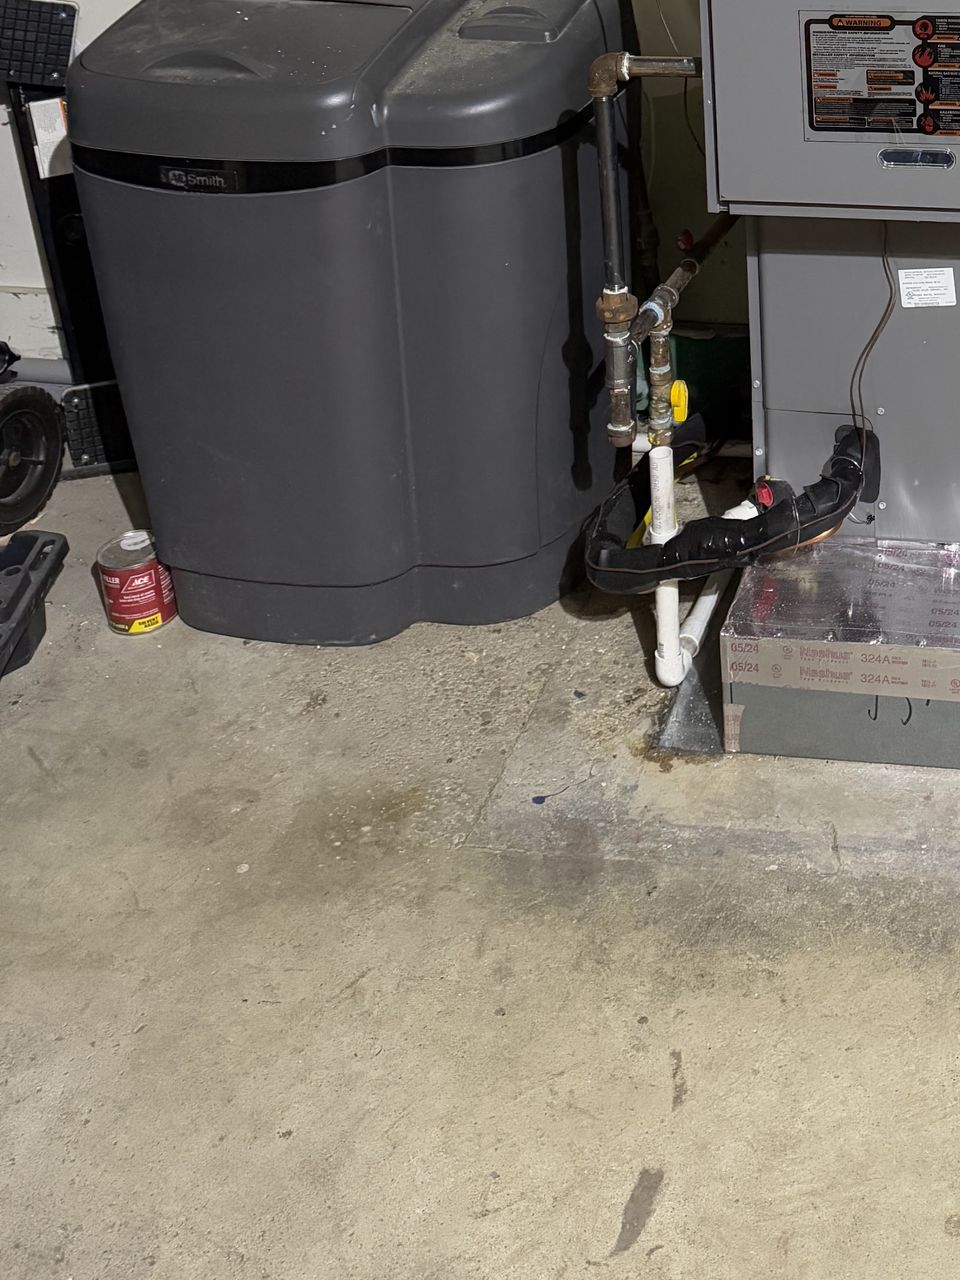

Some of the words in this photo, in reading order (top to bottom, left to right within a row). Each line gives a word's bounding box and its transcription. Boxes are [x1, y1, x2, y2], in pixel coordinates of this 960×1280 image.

[187, 174, 225, 187] Smith
[131, 576, 151, 587] ACE
[931, 608, 960, 616] 05/24
[928, 621, 958, 629] 05/24
[730, 642, 759, 654] 05/24
[799, 646, 852, 660] Nashua
[860, 653, 891, 665] 324A
[730, 662, 759, 673] 05/24
[799, 666, 851, 679] Nashua
[860, 673, 891, 685] 324A
